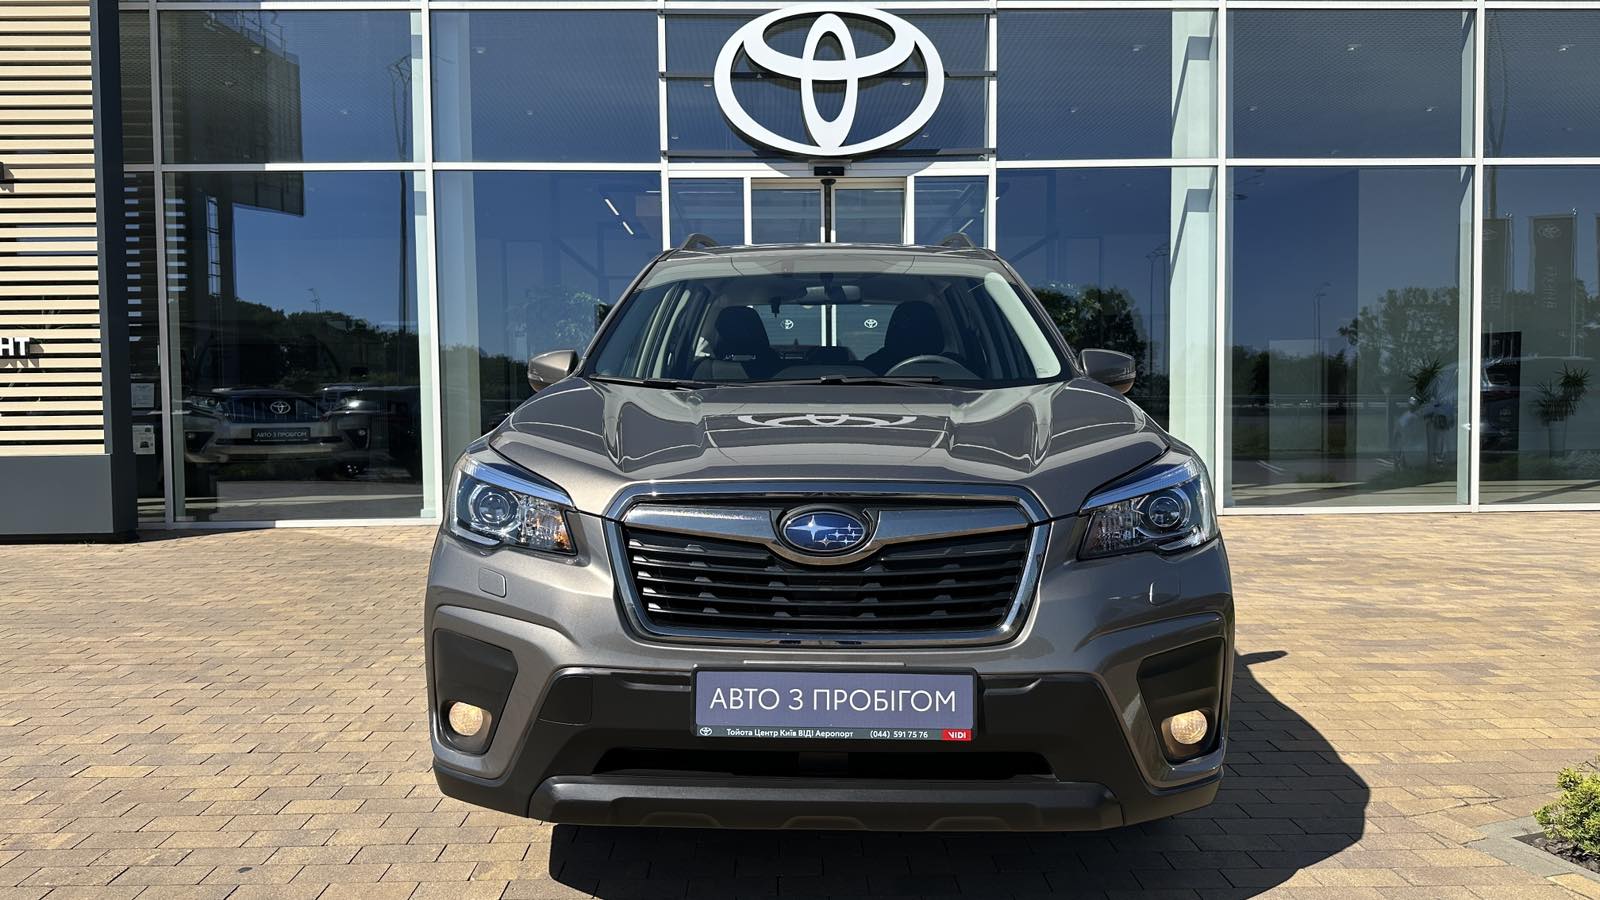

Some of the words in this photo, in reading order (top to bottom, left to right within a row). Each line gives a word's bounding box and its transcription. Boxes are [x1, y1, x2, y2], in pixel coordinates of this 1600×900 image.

[709, 687, 780, 710] АВТО
[788, 688, 804, 711] З
[813, 688, 956, 712] ПРОБІГОМ
[726, 728, 753, 737] Тойота
[755, 729, 779, 738] Центр
[780, 728, 797, 737] Київ
[798, 729, 814, 738] ВІДІ
[815, 729, 854, 739] Аеропорт
[870, 730, 890, 739] (044)
[893, 730, 906, 738] 591
[907, 730, 917, 738] 75
[947, 731, 967, 739] VIDI
